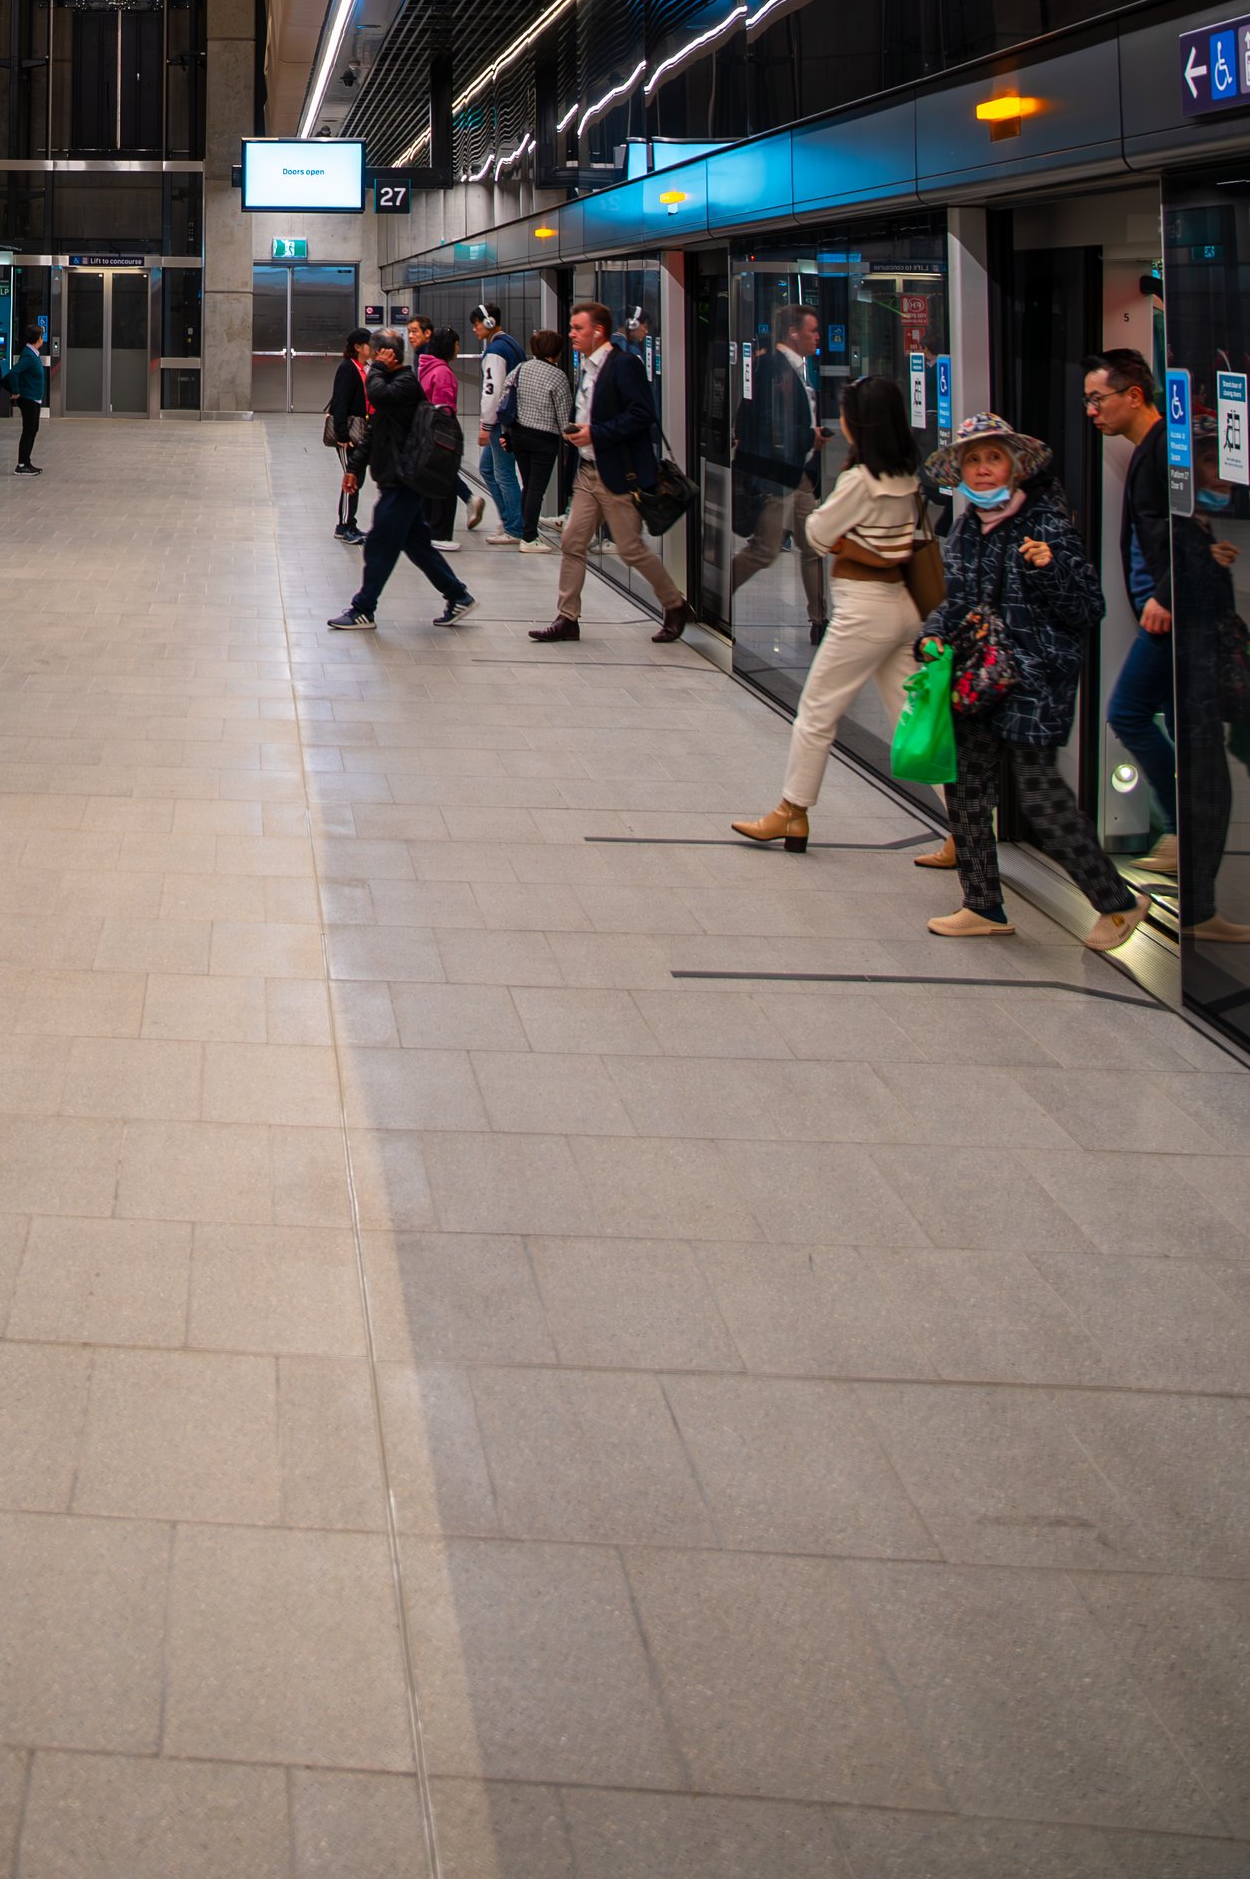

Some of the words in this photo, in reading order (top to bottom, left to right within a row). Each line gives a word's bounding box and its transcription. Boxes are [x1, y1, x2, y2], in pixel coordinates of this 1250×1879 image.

[380, 187, 406, 206] 27
[90, 257, 101, 265] Lift
[1123, 312, 1130, 323] 5
